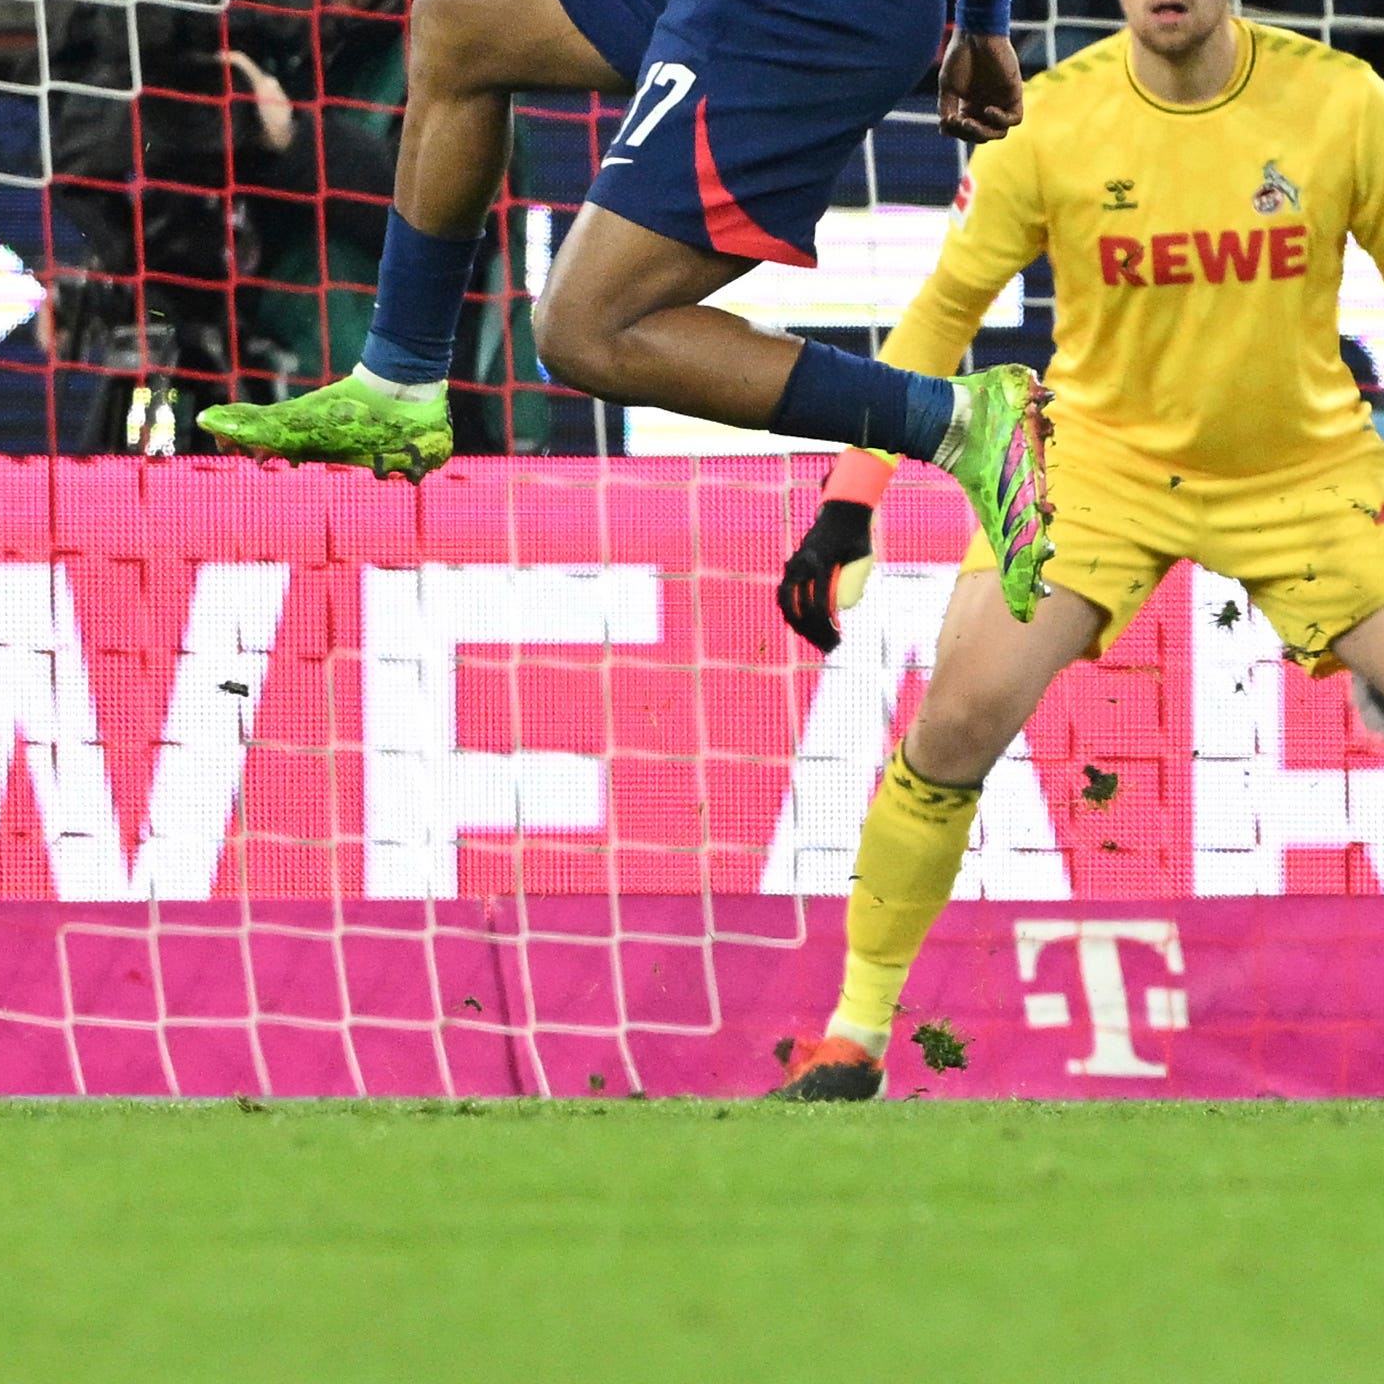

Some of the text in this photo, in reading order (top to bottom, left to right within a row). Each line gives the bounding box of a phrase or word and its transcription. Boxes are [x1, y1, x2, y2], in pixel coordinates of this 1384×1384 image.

[612, 61, 697, 147] 17
[1099, 224, 1308, 287] REWE
[1013, 919, 1190, 1079] T
